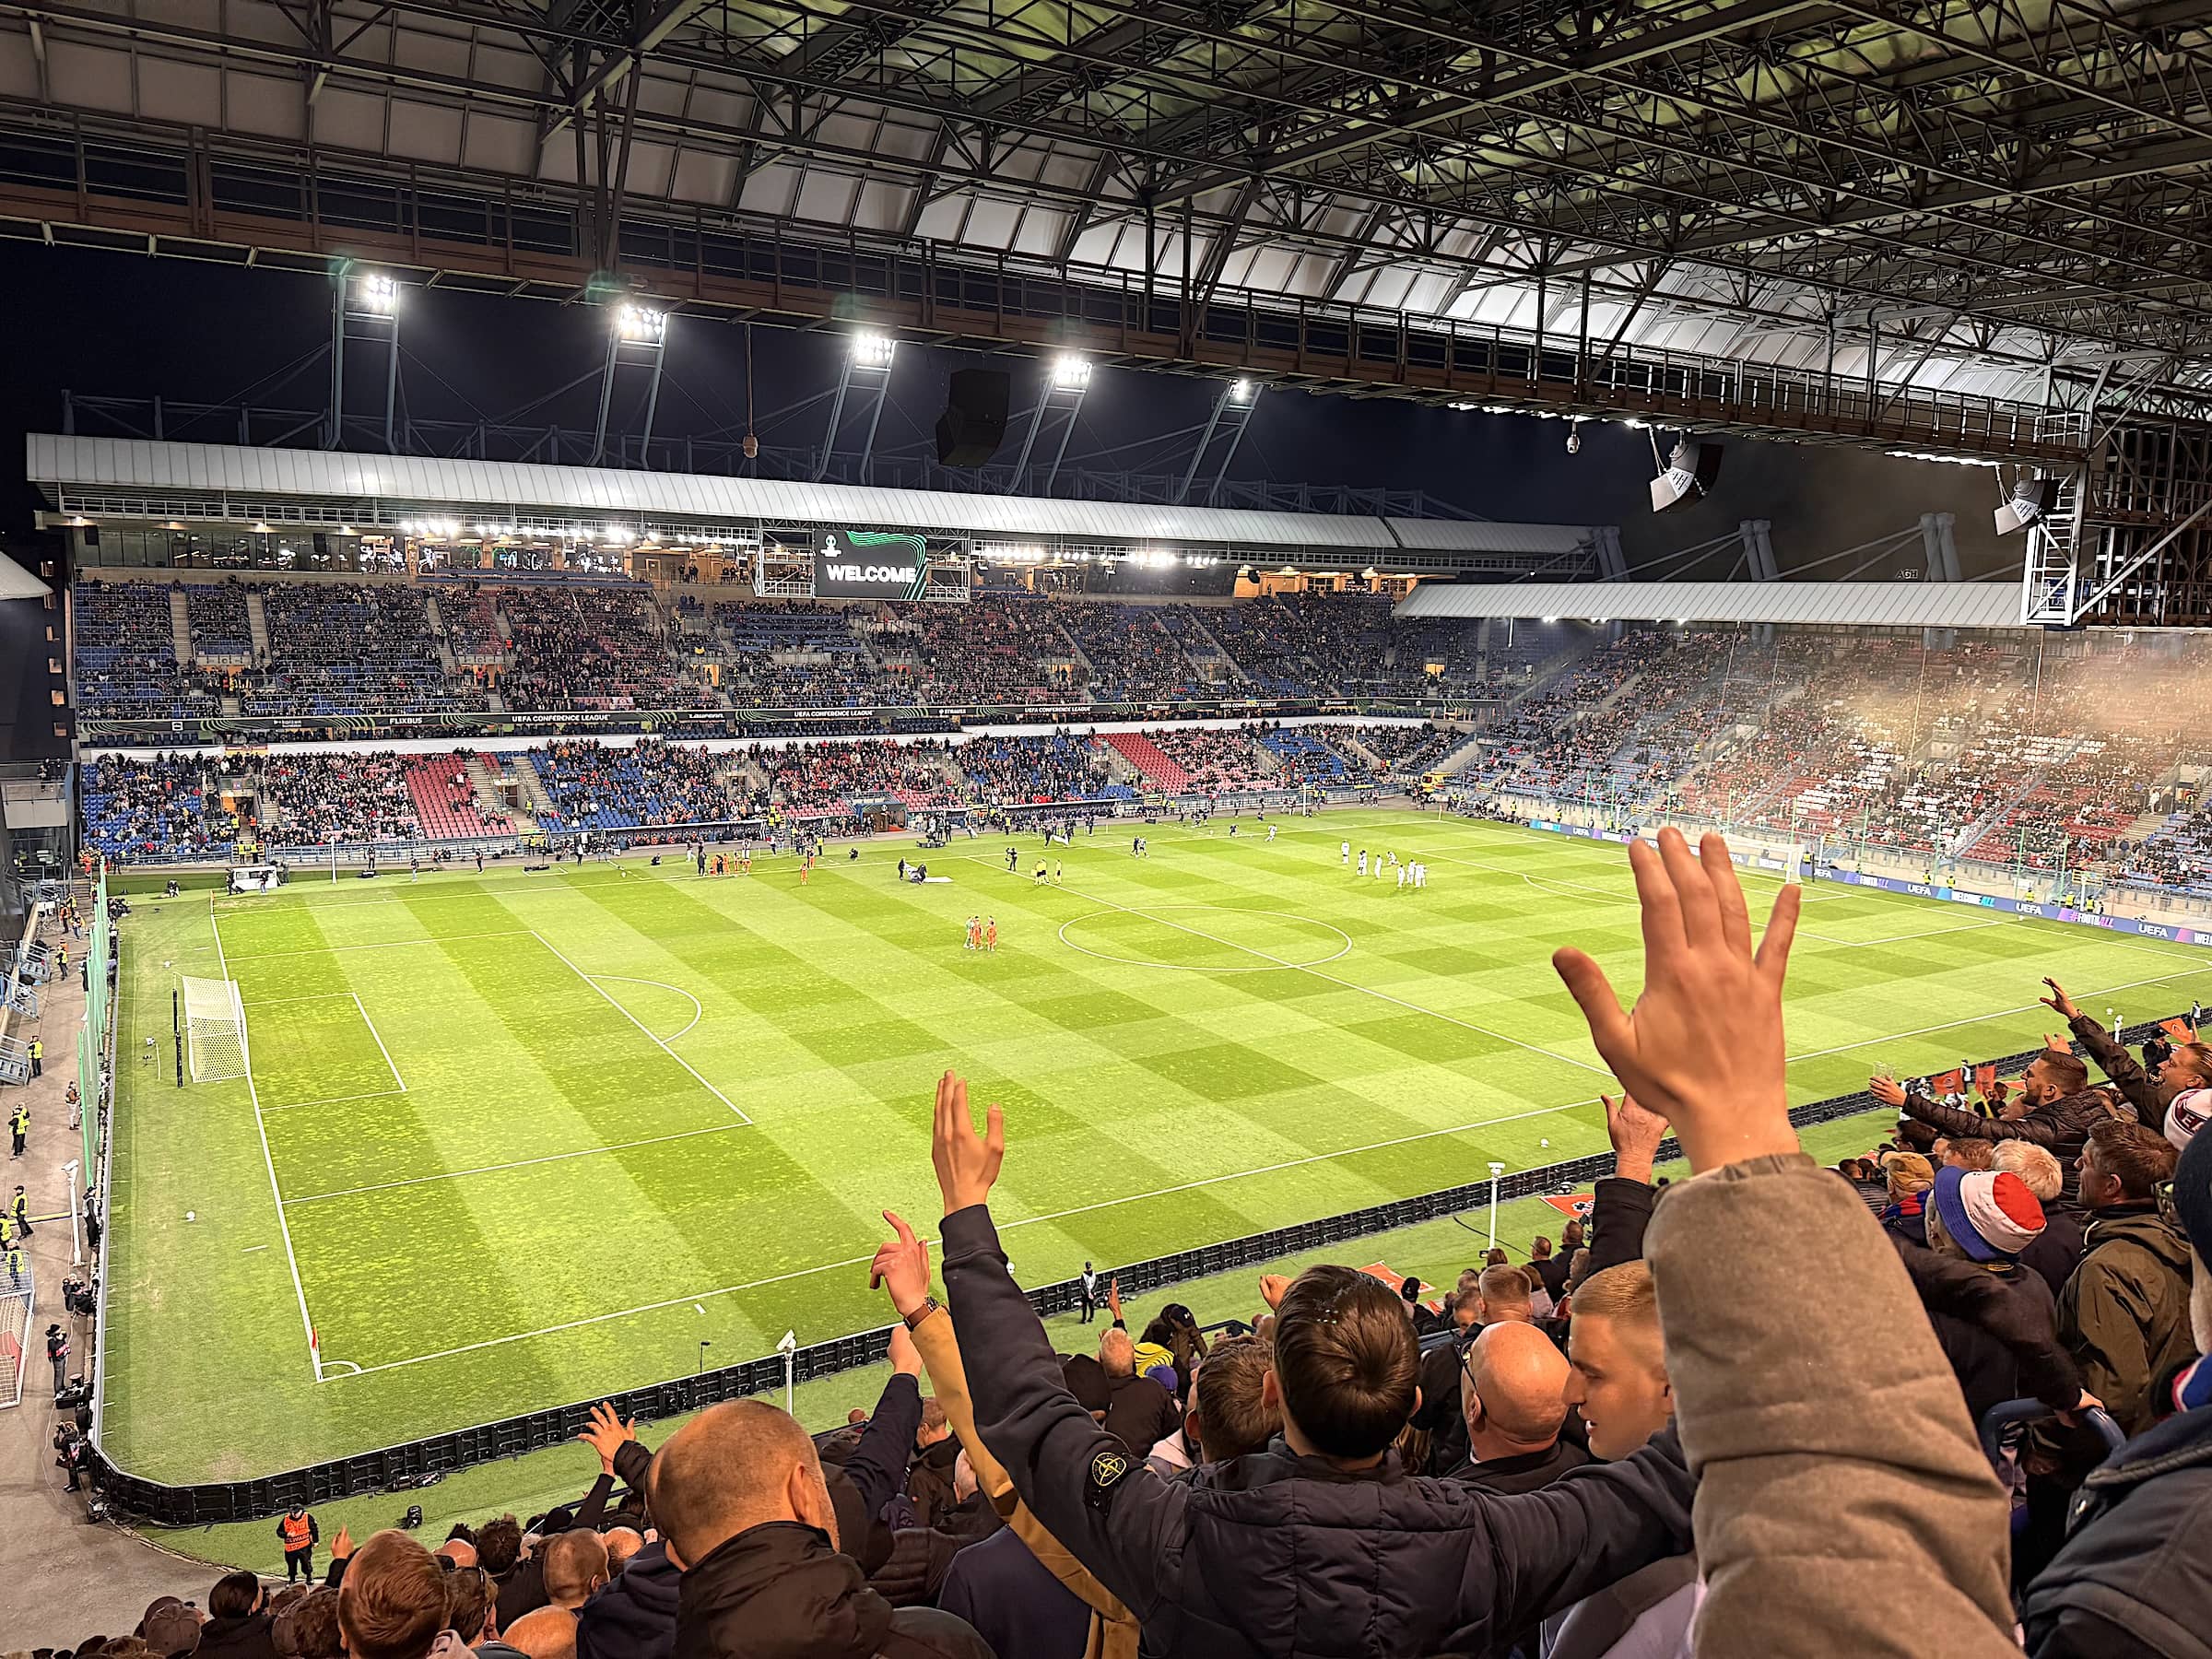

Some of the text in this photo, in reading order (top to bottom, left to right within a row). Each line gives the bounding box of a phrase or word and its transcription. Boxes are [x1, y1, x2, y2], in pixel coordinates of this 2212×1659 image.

[827, 565, 916, 583] WELCOME
[1895, 569, 1919, 580] AGH
[1571, 827, 1591, 837] UEFA
[1907, 884, 1932, 897] UEFA
[2016, 902, 2042, 915] UEFA
[2070, 911, 2114, 928] #FOOTBALL
[2138, 923, 2168, 937] UEFA
